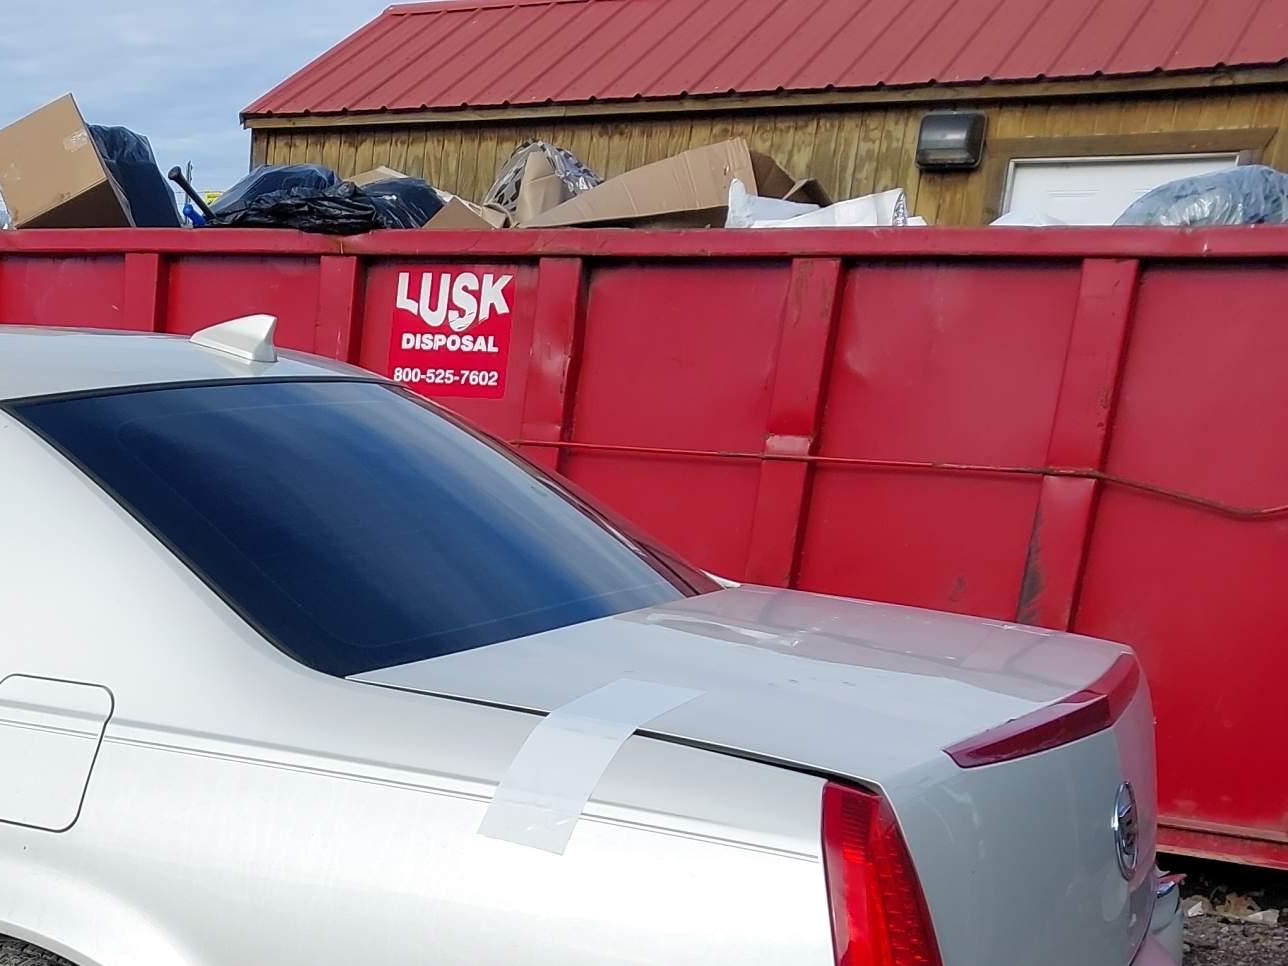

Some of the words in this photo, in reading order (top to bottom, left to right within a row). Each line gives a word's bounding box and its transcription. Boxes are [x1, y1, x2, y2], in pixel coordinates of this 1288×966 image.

[396, 272, 513, 332] LUSK
[401, 333, 499, 353] DISPOSAL
[393, 367, 499, 386] 800-525-7602
